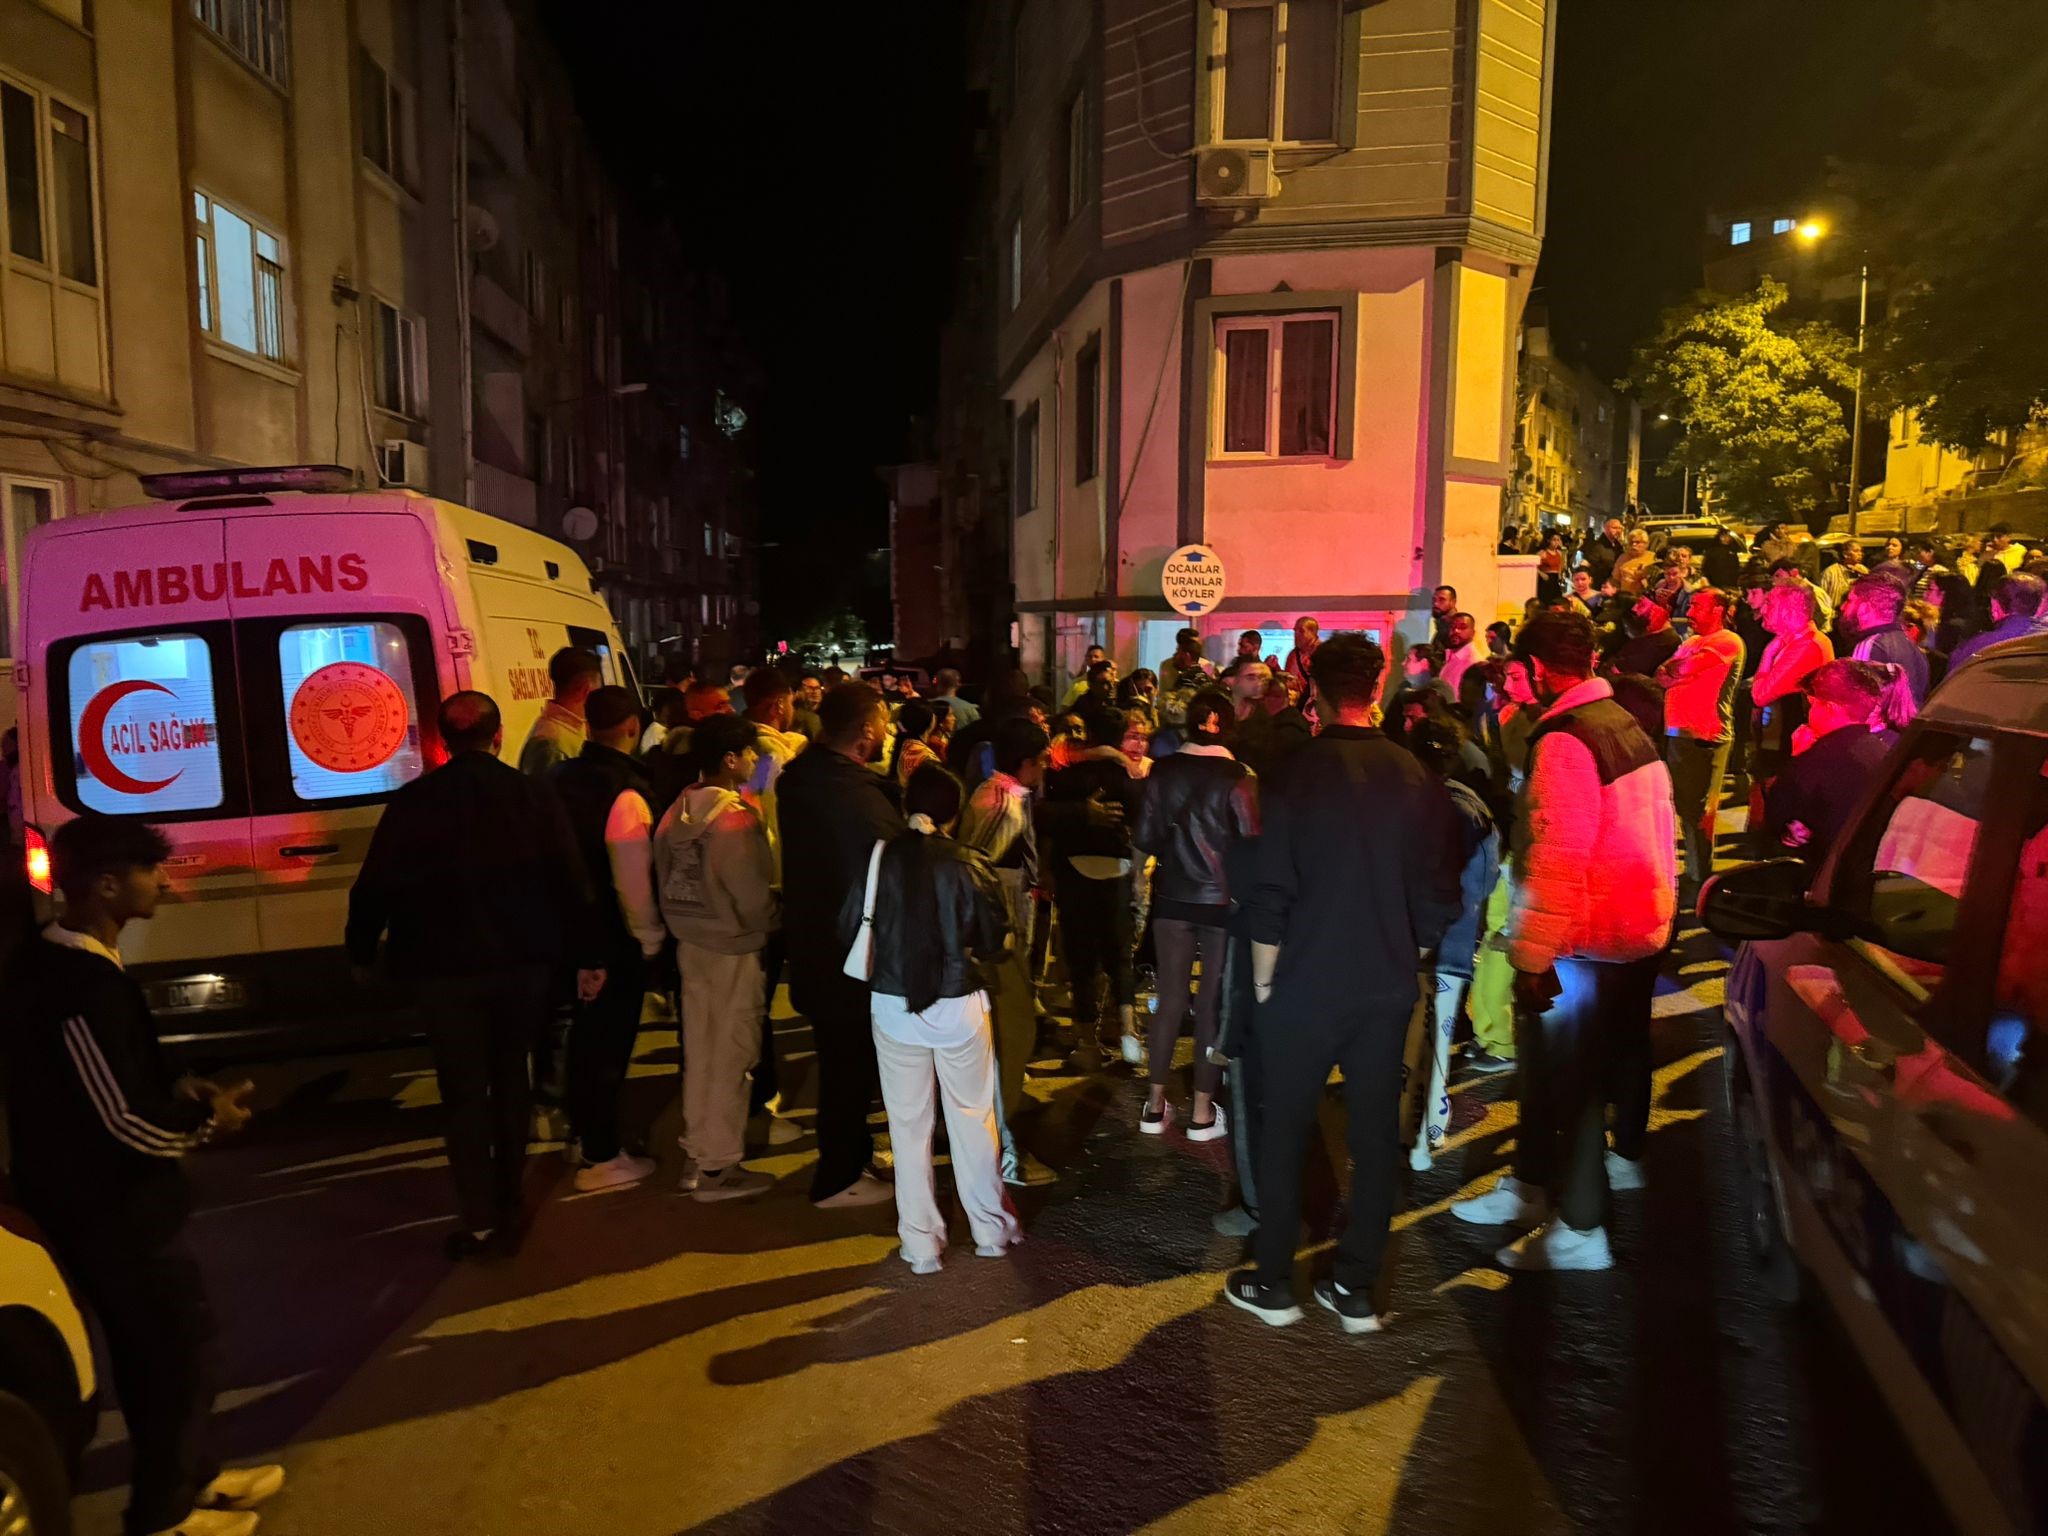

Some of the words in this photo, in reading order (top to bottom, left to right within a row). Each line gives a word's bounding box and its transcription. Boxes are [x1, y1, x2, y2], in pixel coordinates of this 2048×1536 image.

[1167, 564, 1220, 574] OCAKLAR
[79, 553, 368, 612] AMBULANS
[1164, 576, 1223, 586] TURANLAR
[1172, 587, 1215, 598] KÖYLER
[111, 715, 146, 755] ACİL
